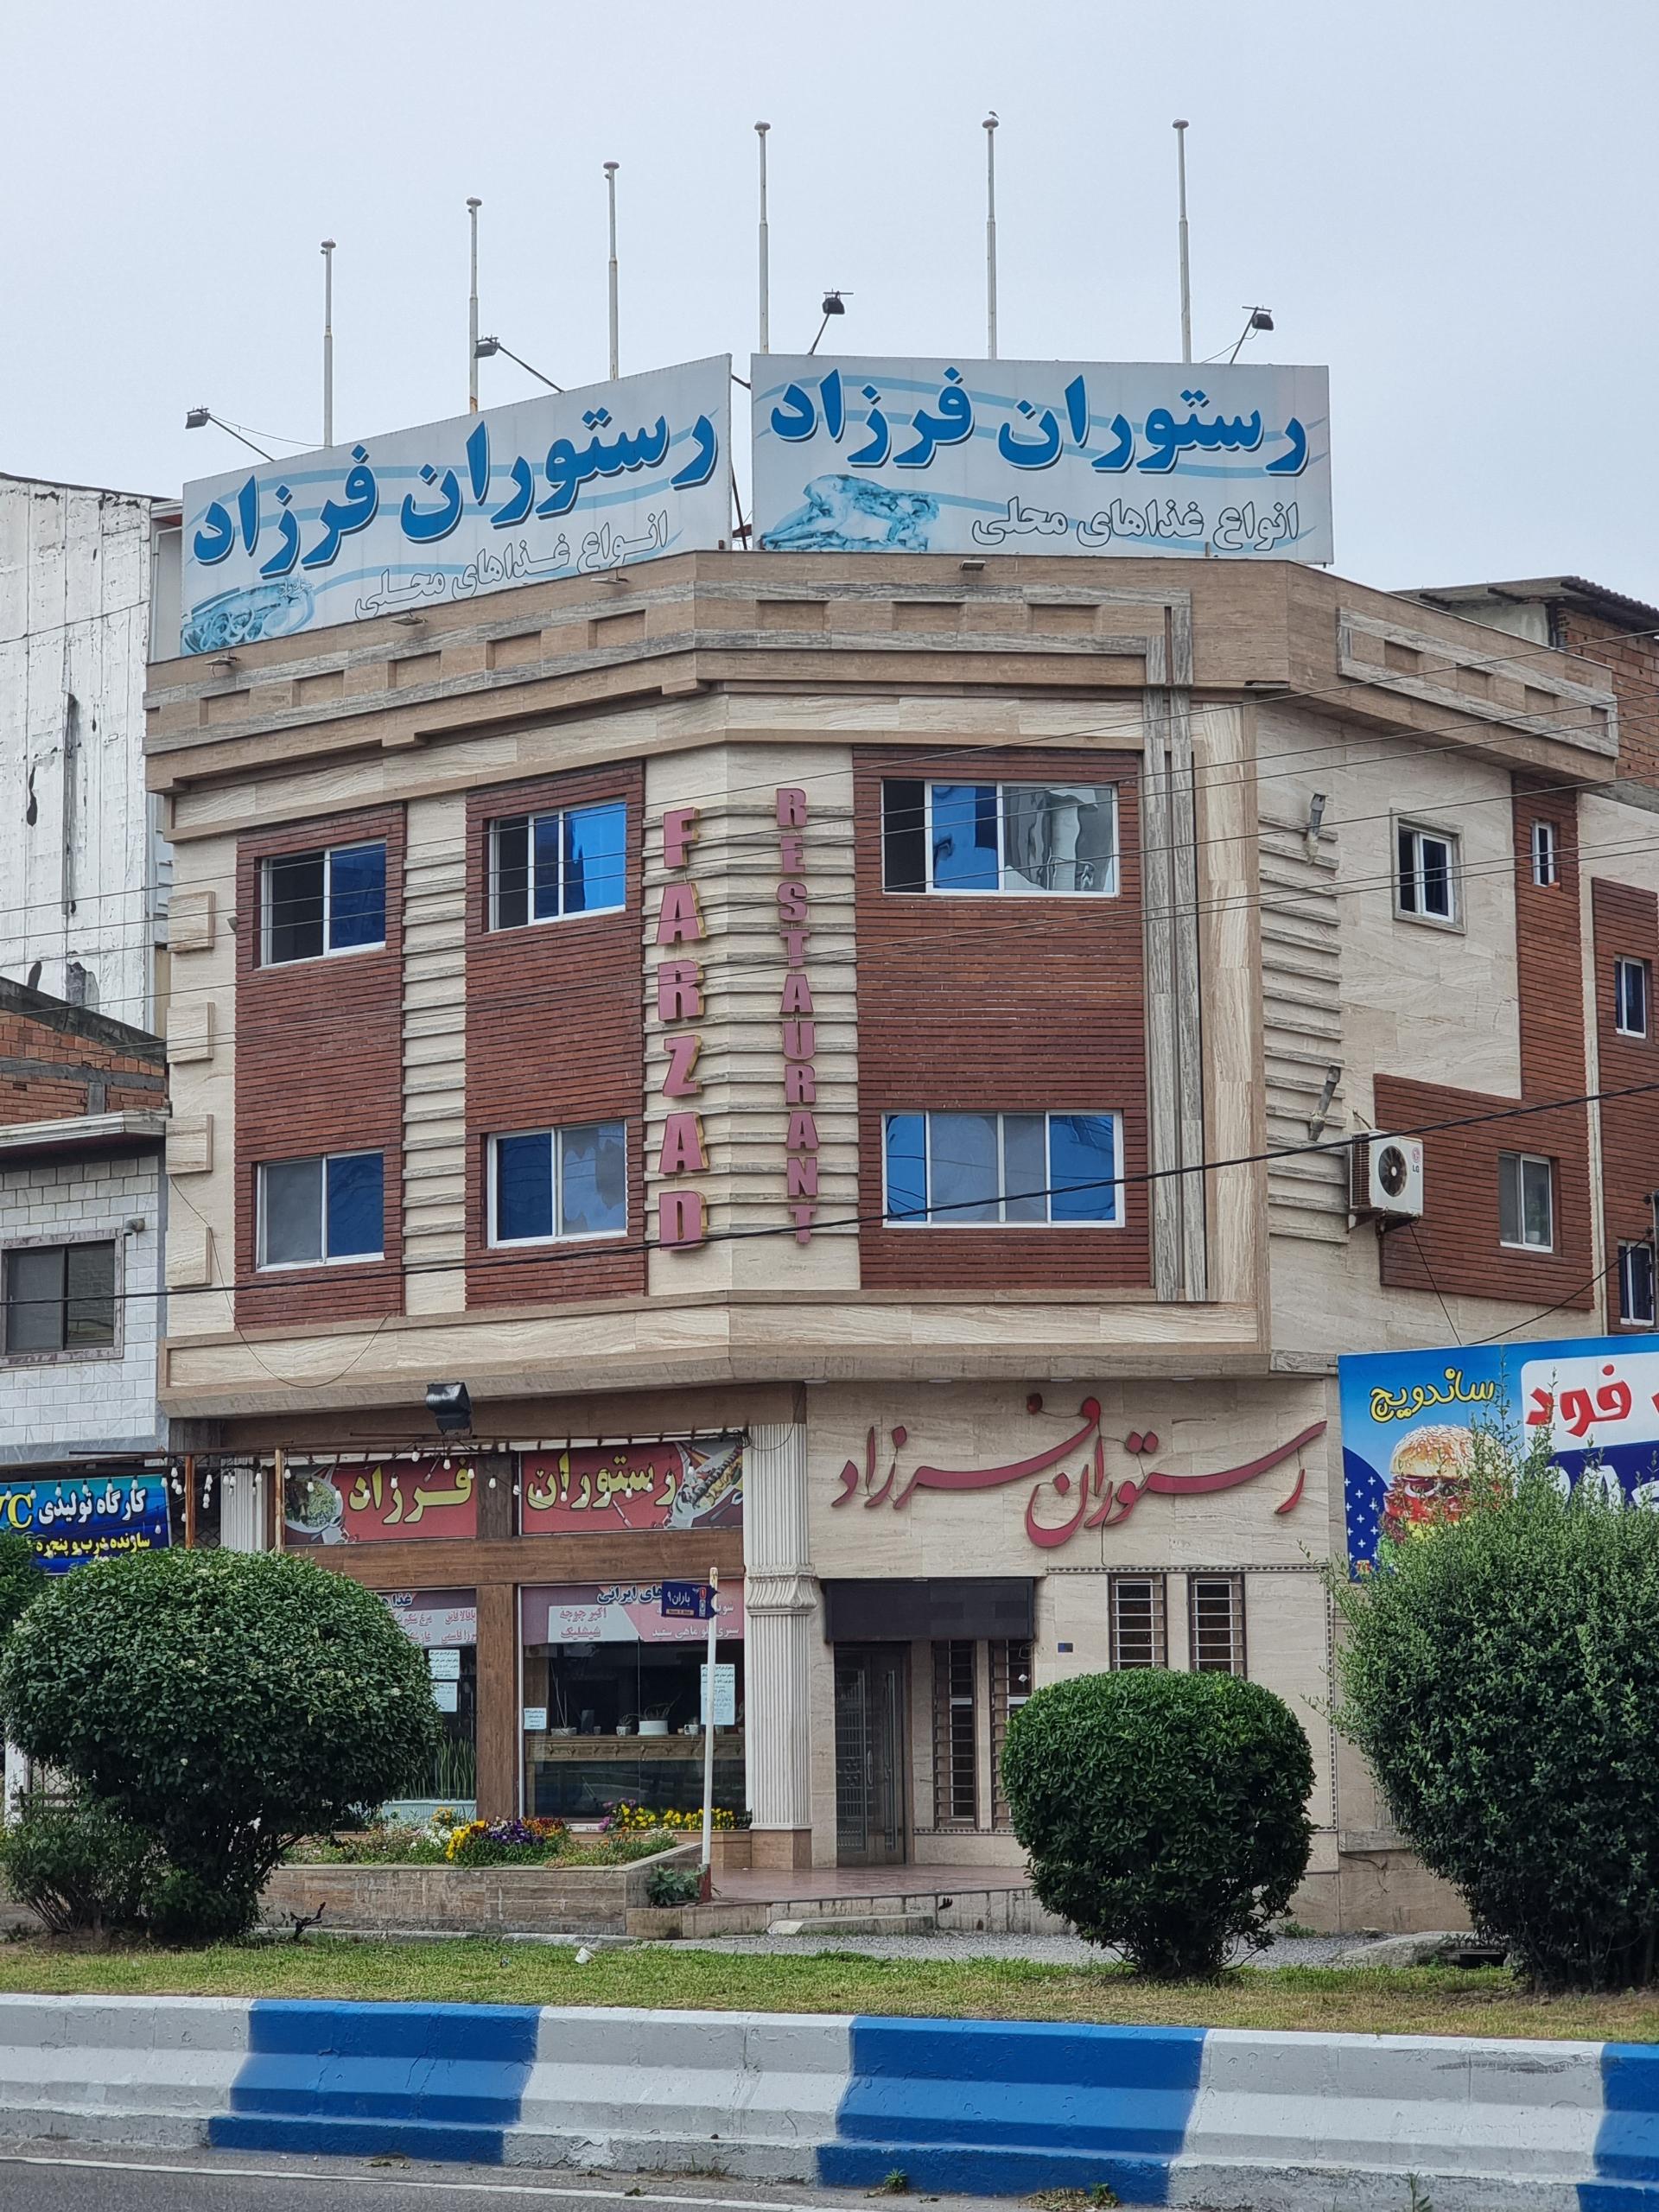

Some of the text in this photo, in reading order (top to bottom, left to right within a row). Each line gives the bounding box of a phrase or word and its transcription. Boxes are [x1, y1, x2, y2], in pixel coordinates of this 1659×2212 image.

[770, 365, 1310, 475] رستوران فرزاد
[193, 407, 721, 579] رستوران فرزاد
[972, 496, 1298, 550] انواع غذاهای محلی
[355, 510, 668, 620] انواع غذاهای محلی
[657, 807, 710, 1252] FARZAD
[776, 787, 819, 1244] RESTAURANT
[1370, 1367, 1495, 1423] ساندویچ
[1526, 1364, 1631, 1438] فود
[348, 1451, 677, 1525] رستوران فرزاد
[831, 1392, 1327, 1548] رستوران فرزاد
[39, 1491, 92, 1524] تولیدی
[71, 1539, 82, 1555] و
[110, 1532, 150, 1553] سازنده
[560, 1606, 587, 1623] جوجه
[597, 1584, 637, 1604] ایرانی
[667, 1591, 690, 1606] باران ۹
[560, 1625, 601, 1640] شیشلیک
[675, 1625, 698, 1639] ماهی
